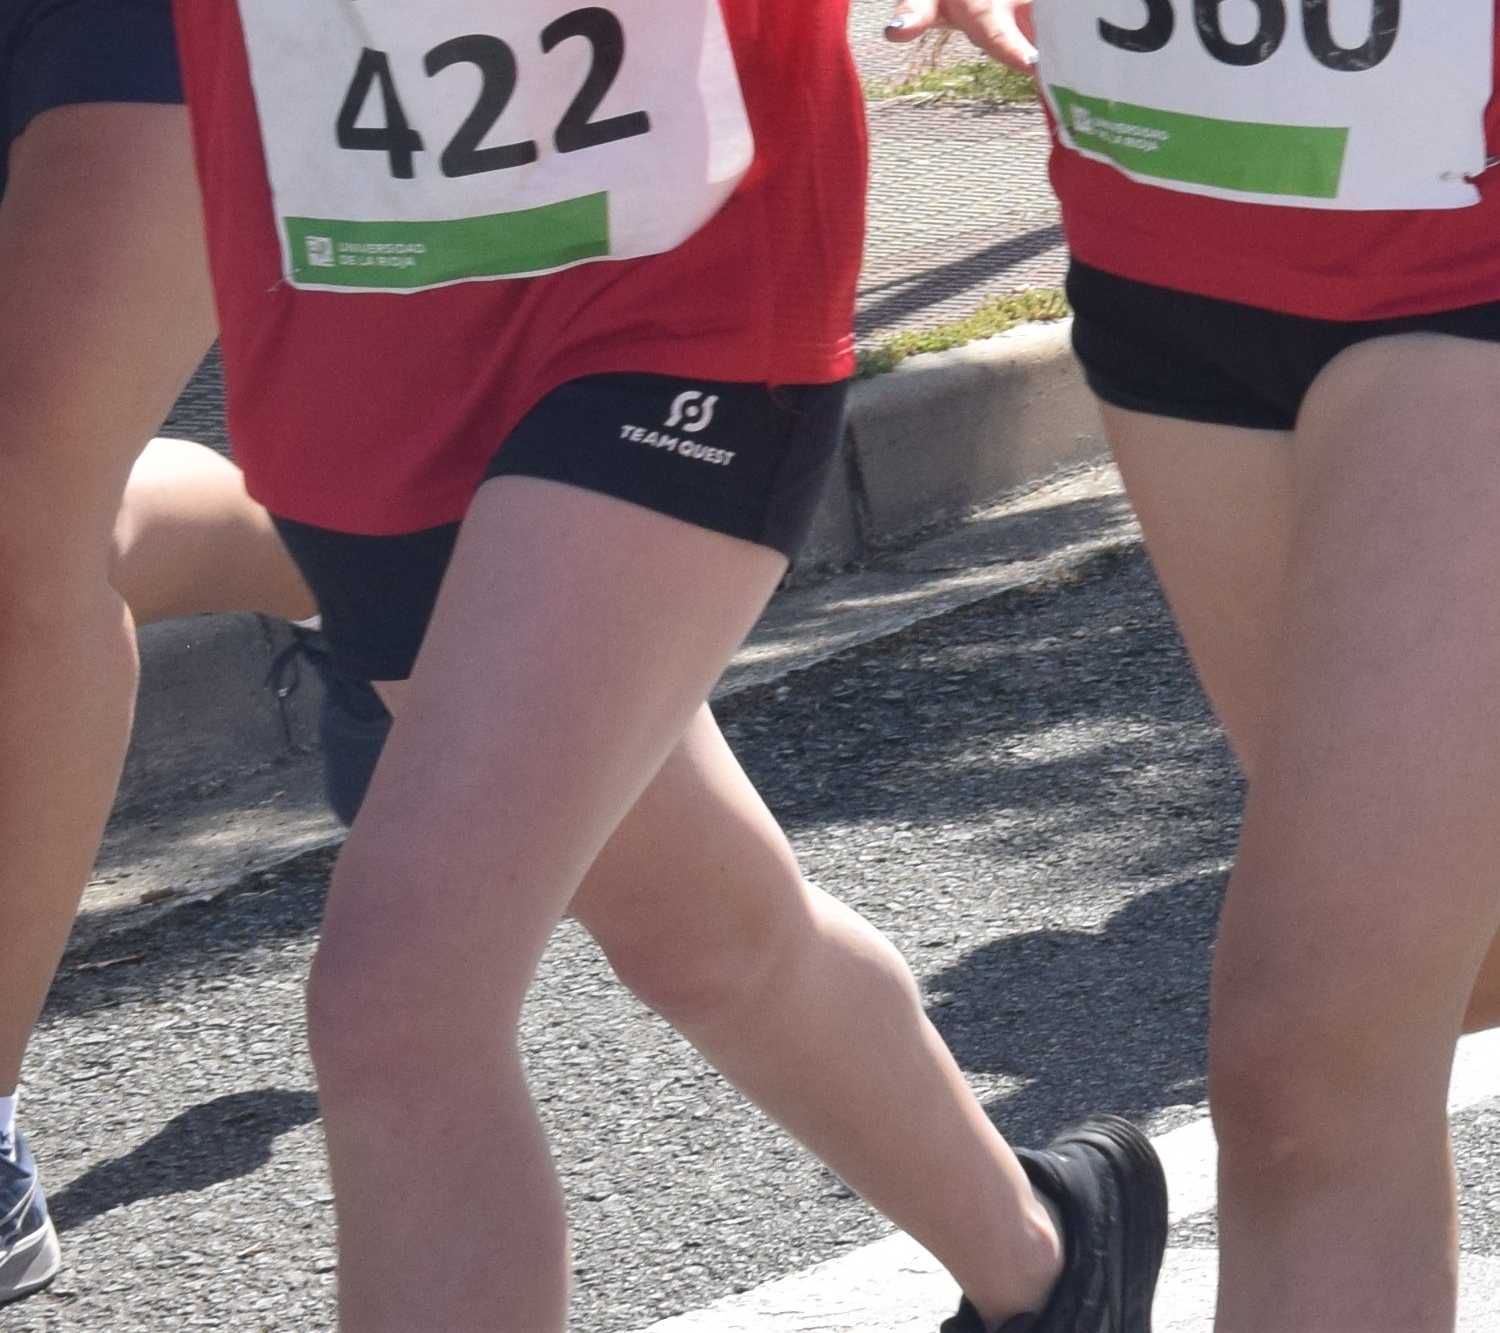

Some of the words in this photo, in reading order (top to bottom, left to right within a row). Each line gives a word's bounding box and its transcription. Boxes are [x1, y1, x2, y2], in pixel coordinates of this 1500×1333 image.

[336, 5, 652, 181] 422
[618, 424, 679, 452] TEAM
[677, 440, 737, 466] QUEST
